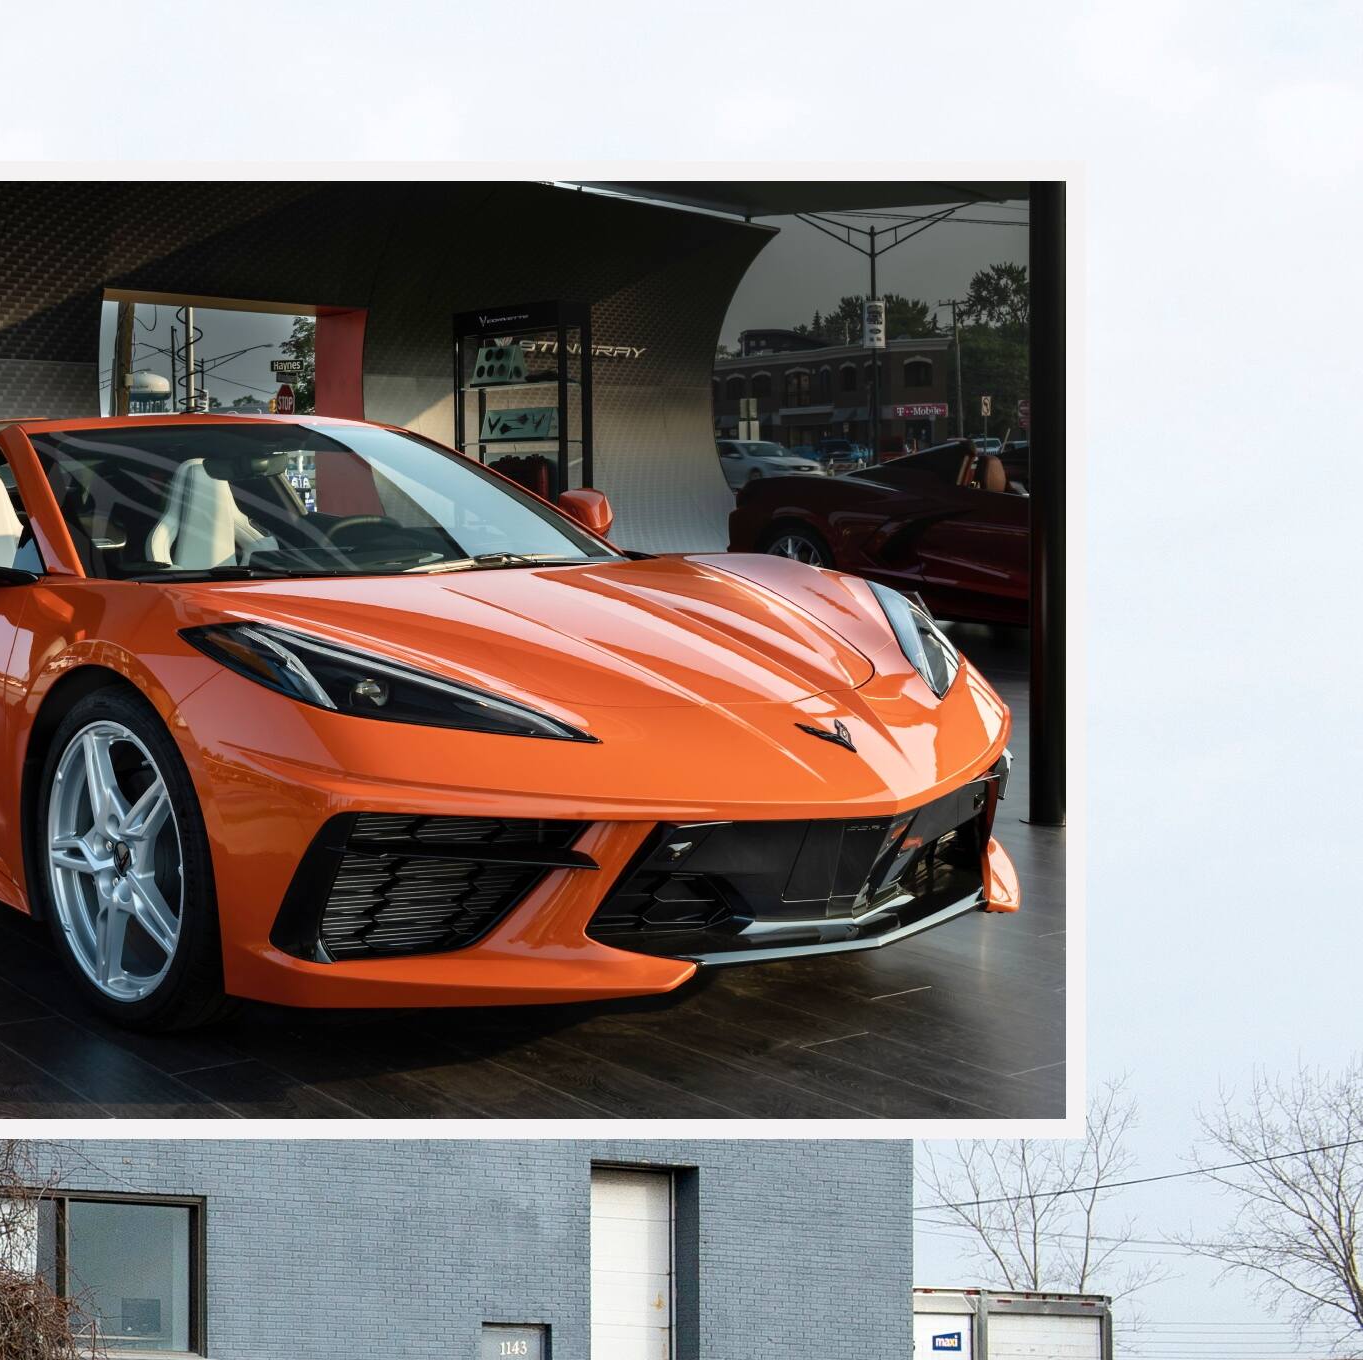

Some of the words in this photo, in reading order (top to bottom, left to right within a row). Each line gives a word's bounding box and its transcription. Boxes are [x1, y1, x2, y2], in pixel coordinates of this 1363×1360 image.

[273, 361, 301, 371] Haynes
[278, 396, 293, 410] STOP
[935, 1334, 958, 1347] maxi
[499, 1340, 527, 1355] 1143
